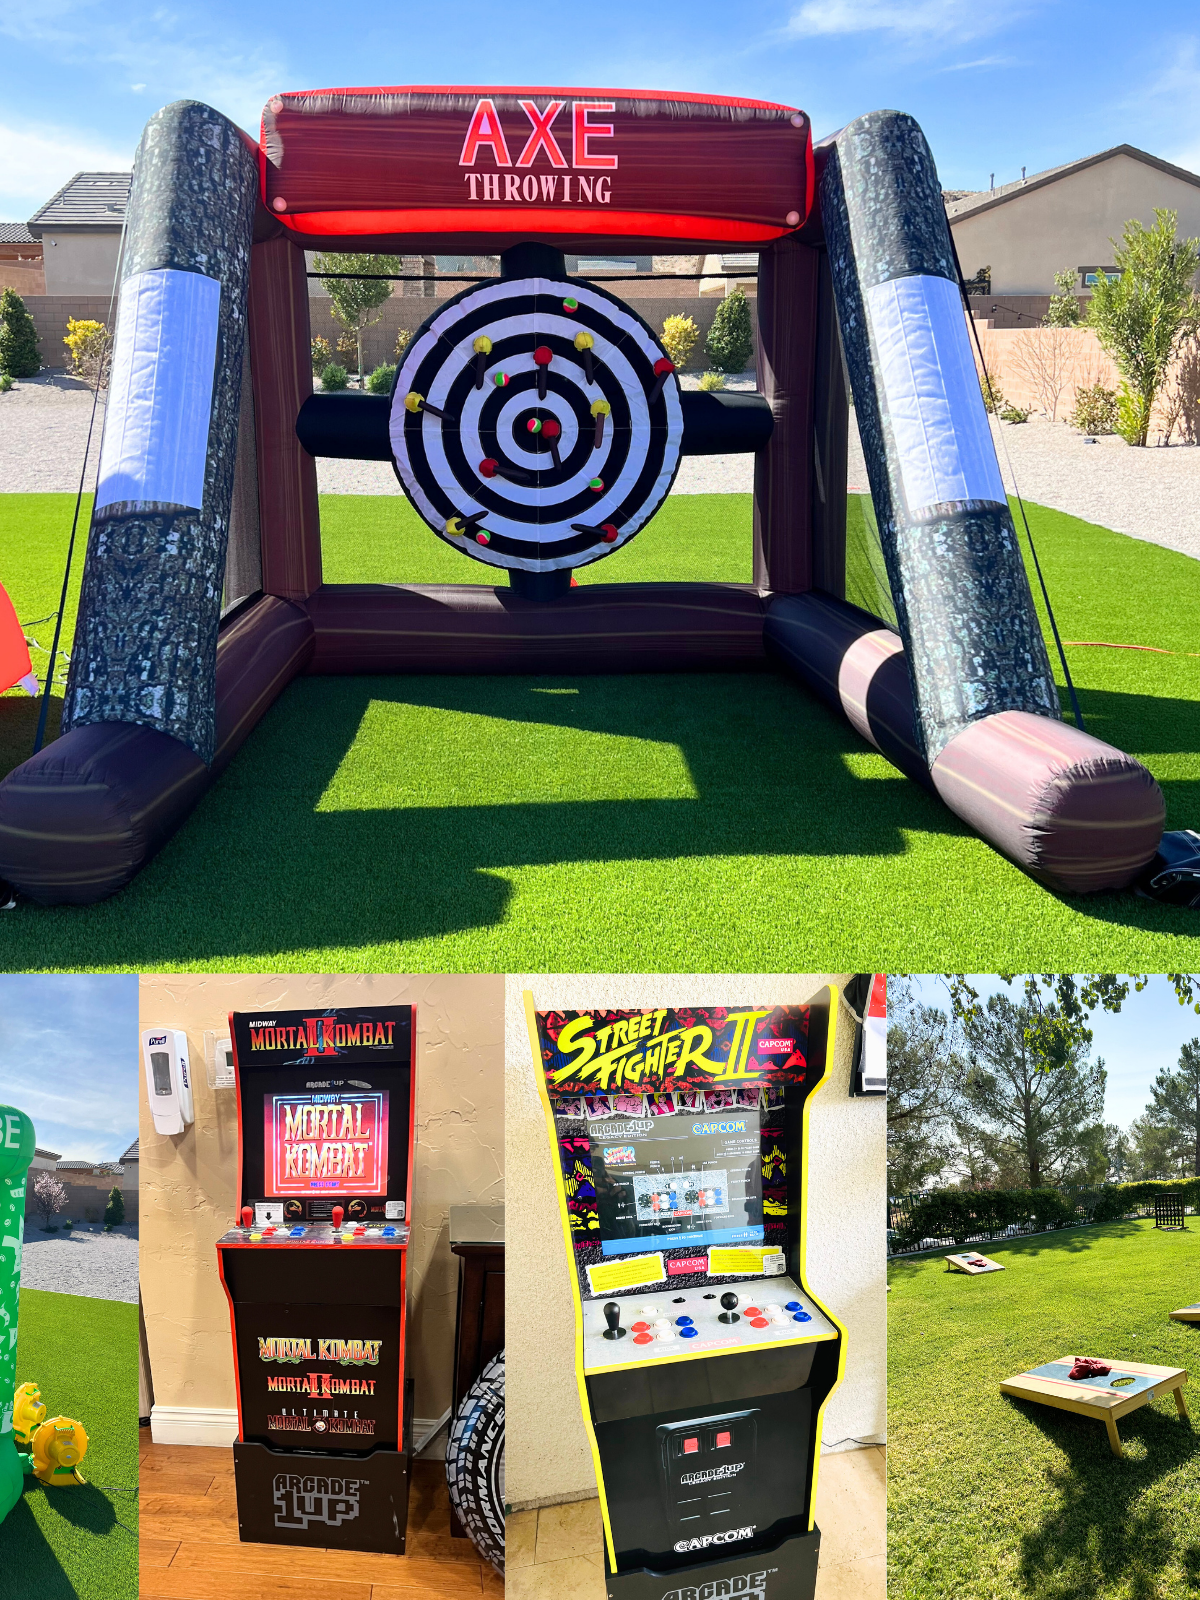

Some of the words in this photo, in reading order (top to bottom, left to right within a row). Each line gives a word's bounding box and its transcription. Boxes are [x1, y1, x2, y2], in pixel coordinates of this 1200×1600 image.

[459, 98, 618, 170] AXE
[464, 173, 612, 204] THROWING
[249, 1020, 277, 1028] MIDWAY
[250, 1025, 319, 1051] MORTAL
[322, 1022, 396, 1048] KOMBAT
[550, 1009, 668, 1085] STREET
[576, 1025, 726, 1090] FIGHTER
[713, 1010, 776, 1082] II
[759, 1040, 791, 1048] CAPCOM
[312, 1094, 340, 1103] MIDWAY
[284, 1103, 370, 1141] MORTAL
[692, 1120, 747, 1135] CAPCOM
[284, 1142, 369, 1179] KOMBAT
[669, 1258, 705, 1269] CAPCOM
[257, 1337, 316, 1360] MORTAL
[318, 1339, 382, 1361] KOMBAT
[691, 1337, 739, 1349] CAPCOM
[267, 1376, 319, 1393] MORTAL
[321, 1378, 376, 1395] KOMBAT
[267, 1415, 311, 1431] MORTAL
[329, 1418, 376, 1435] KOMBAT
[281, 1408, 359, 1419] ULTIMATE
[273, 1473, 360, 1500] ARCADE
[674, 1526, 754, 1553] CAPCOM
[661, 1570, 767, 1600] ARCADE
